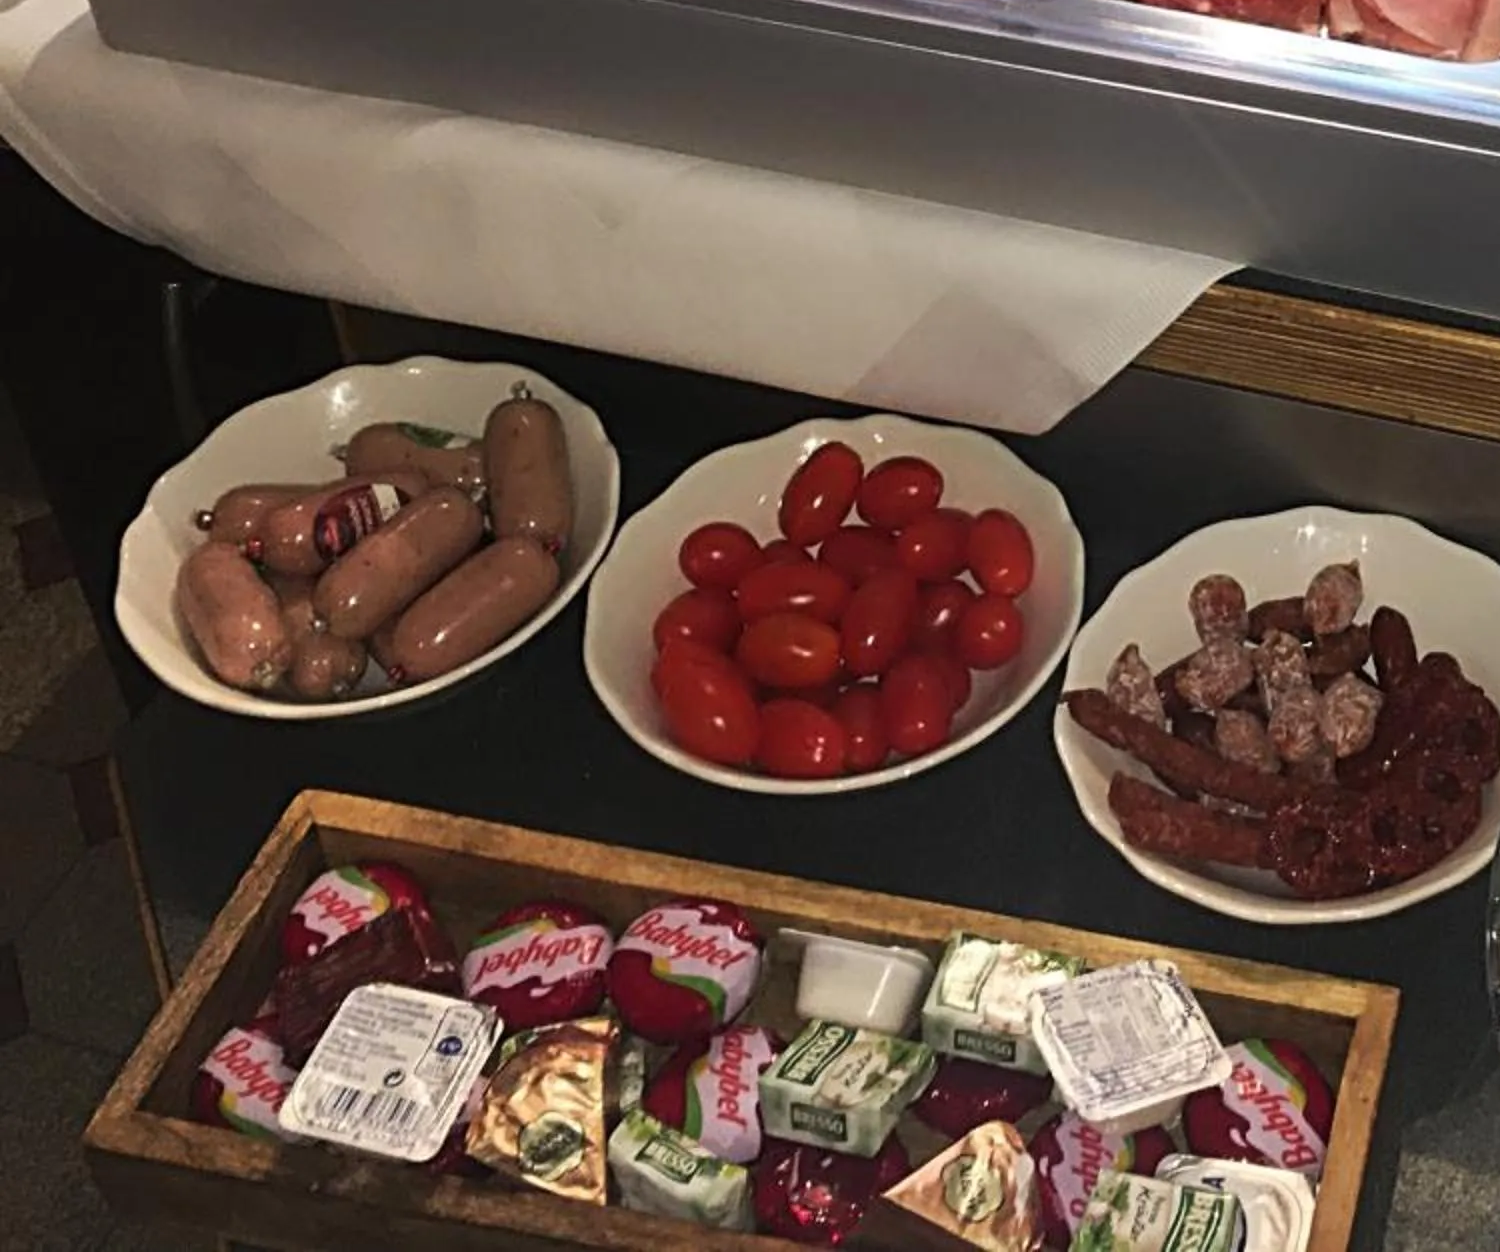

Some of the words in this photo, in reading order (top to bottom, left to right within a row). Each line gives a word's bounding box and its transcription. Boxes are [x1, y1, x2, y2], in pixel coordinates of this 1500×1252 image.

[304, 884, 373, 931] ybel
[473, 933, 606, 984] Babybel
[630, 912, 746, 970] Babybel
[787, 1026, 845, 1080] BRESSO
